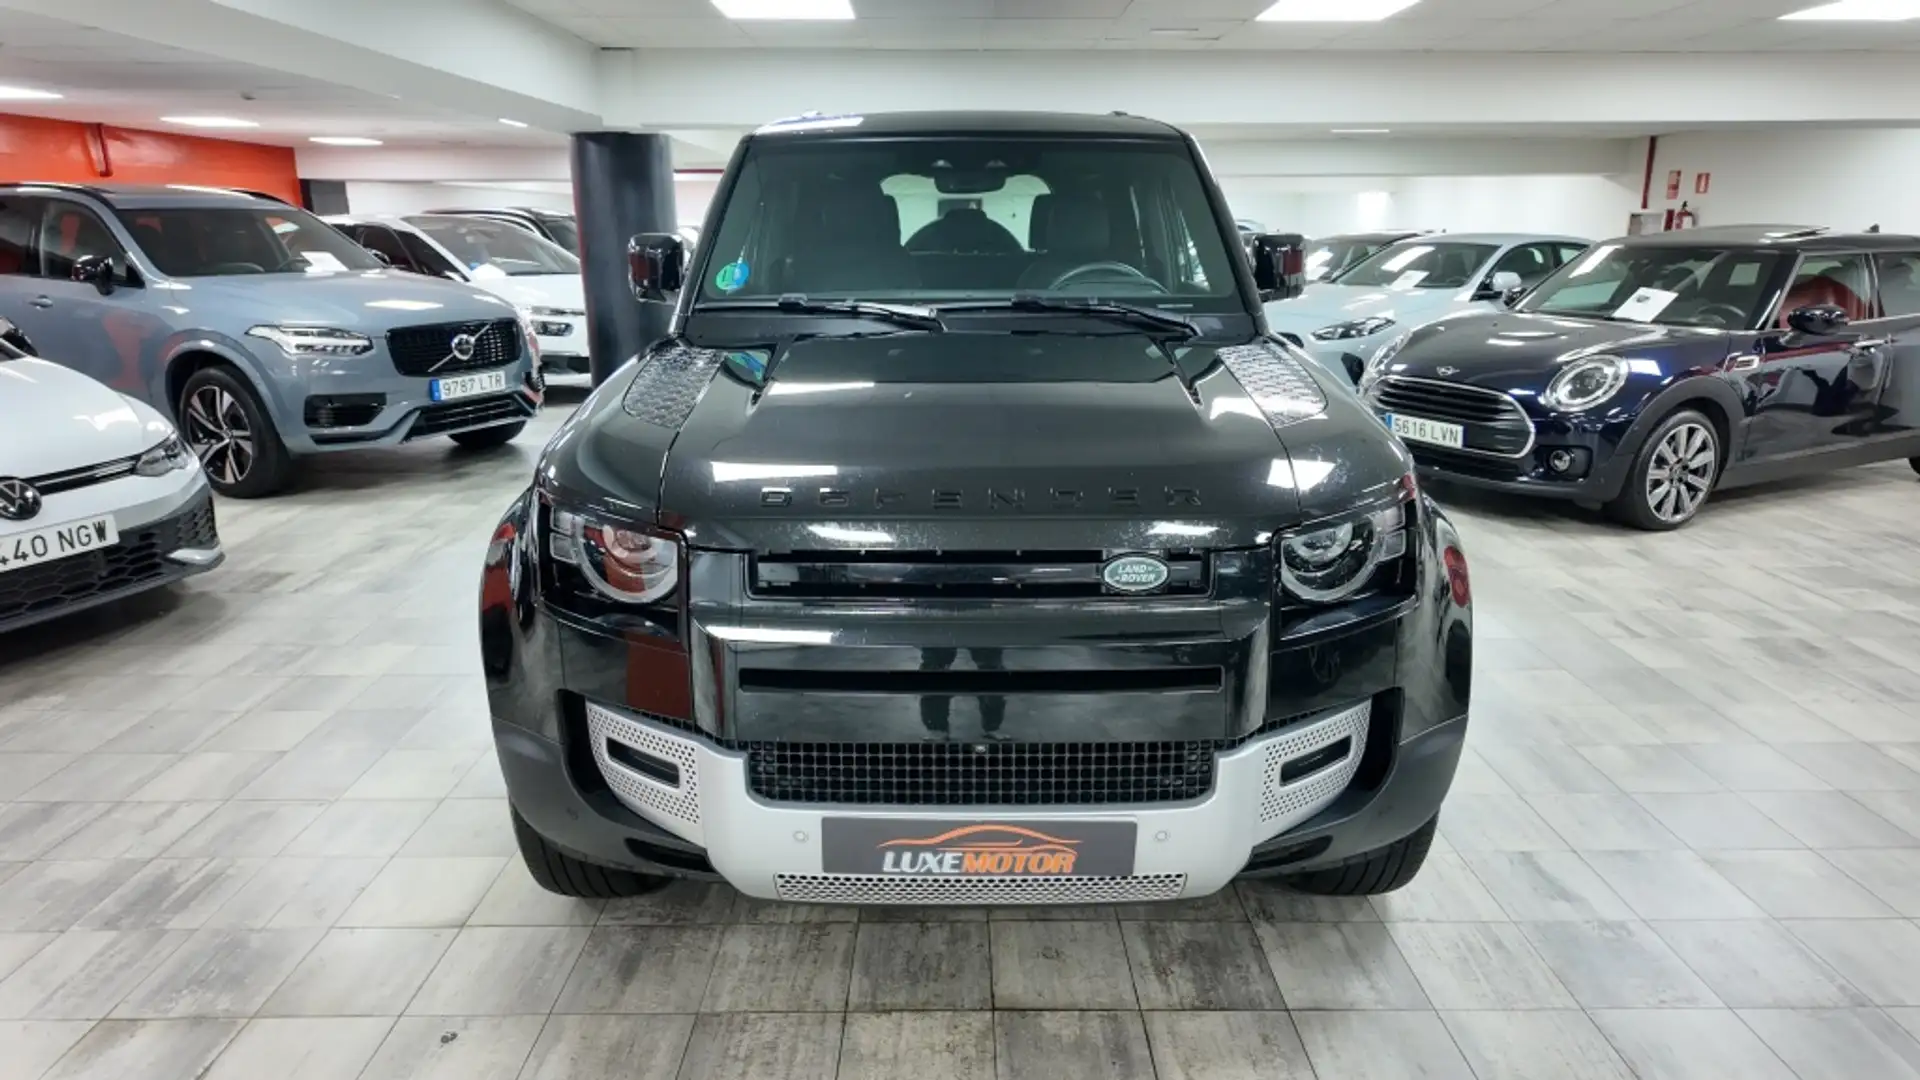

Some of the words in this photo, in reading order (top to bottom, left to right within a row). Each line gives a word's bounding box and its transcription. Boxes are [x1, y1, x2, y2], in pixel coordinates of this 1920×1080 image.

[443, 377, 475, 396] 9787
[479, 374, 502, 391] LTR
[1395, 417, 1426, 438] 5616
[1431, 425, 1459, 444] LVN
[759, 486, 1201, 509] DEFENDER
[56, 519, 107, 552] NGW
[1118, 564, 1147, 574] LAND
[1121, 573, 1156, 583] ROVER
[882, 851, 1075, 874] LUXEMOTOR
